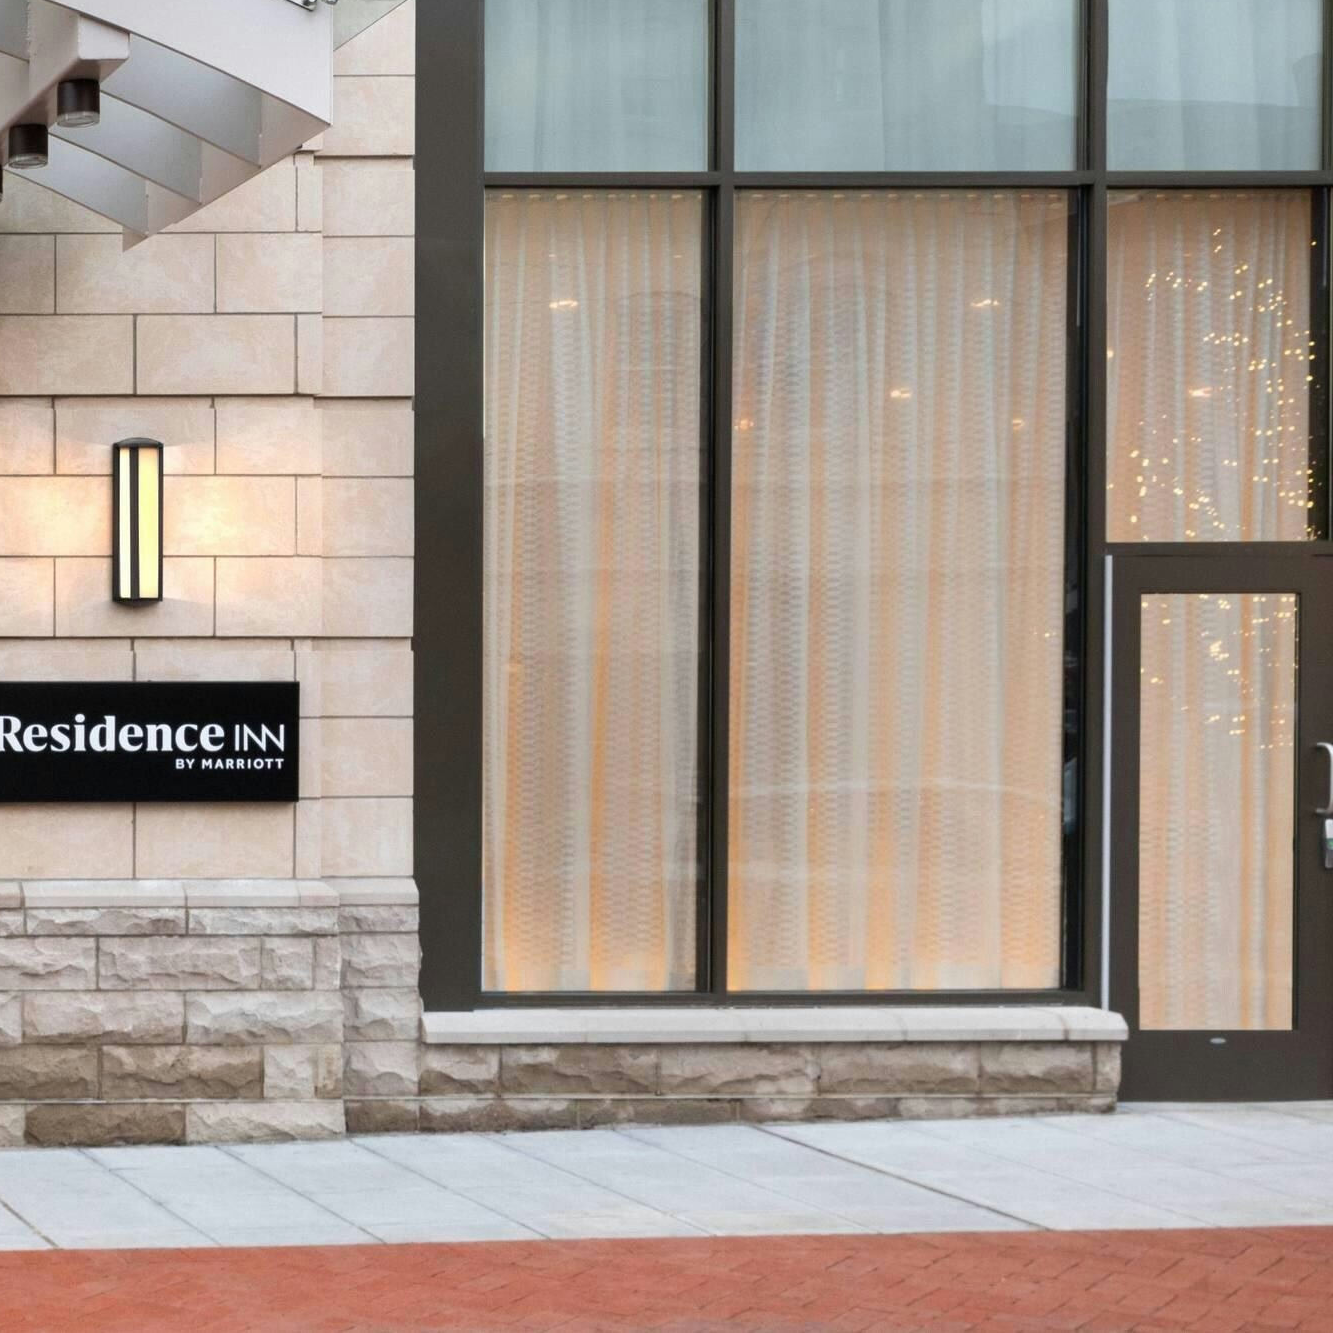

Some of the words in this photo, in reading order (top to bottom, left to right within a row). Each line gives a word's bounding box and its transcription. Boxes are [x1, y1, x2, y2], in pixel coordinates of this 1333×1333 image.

[234, 723, 285, 752] INN
[175, 758, 195, 770] BY
[201, 758, 285, 770] MARRIOTT
